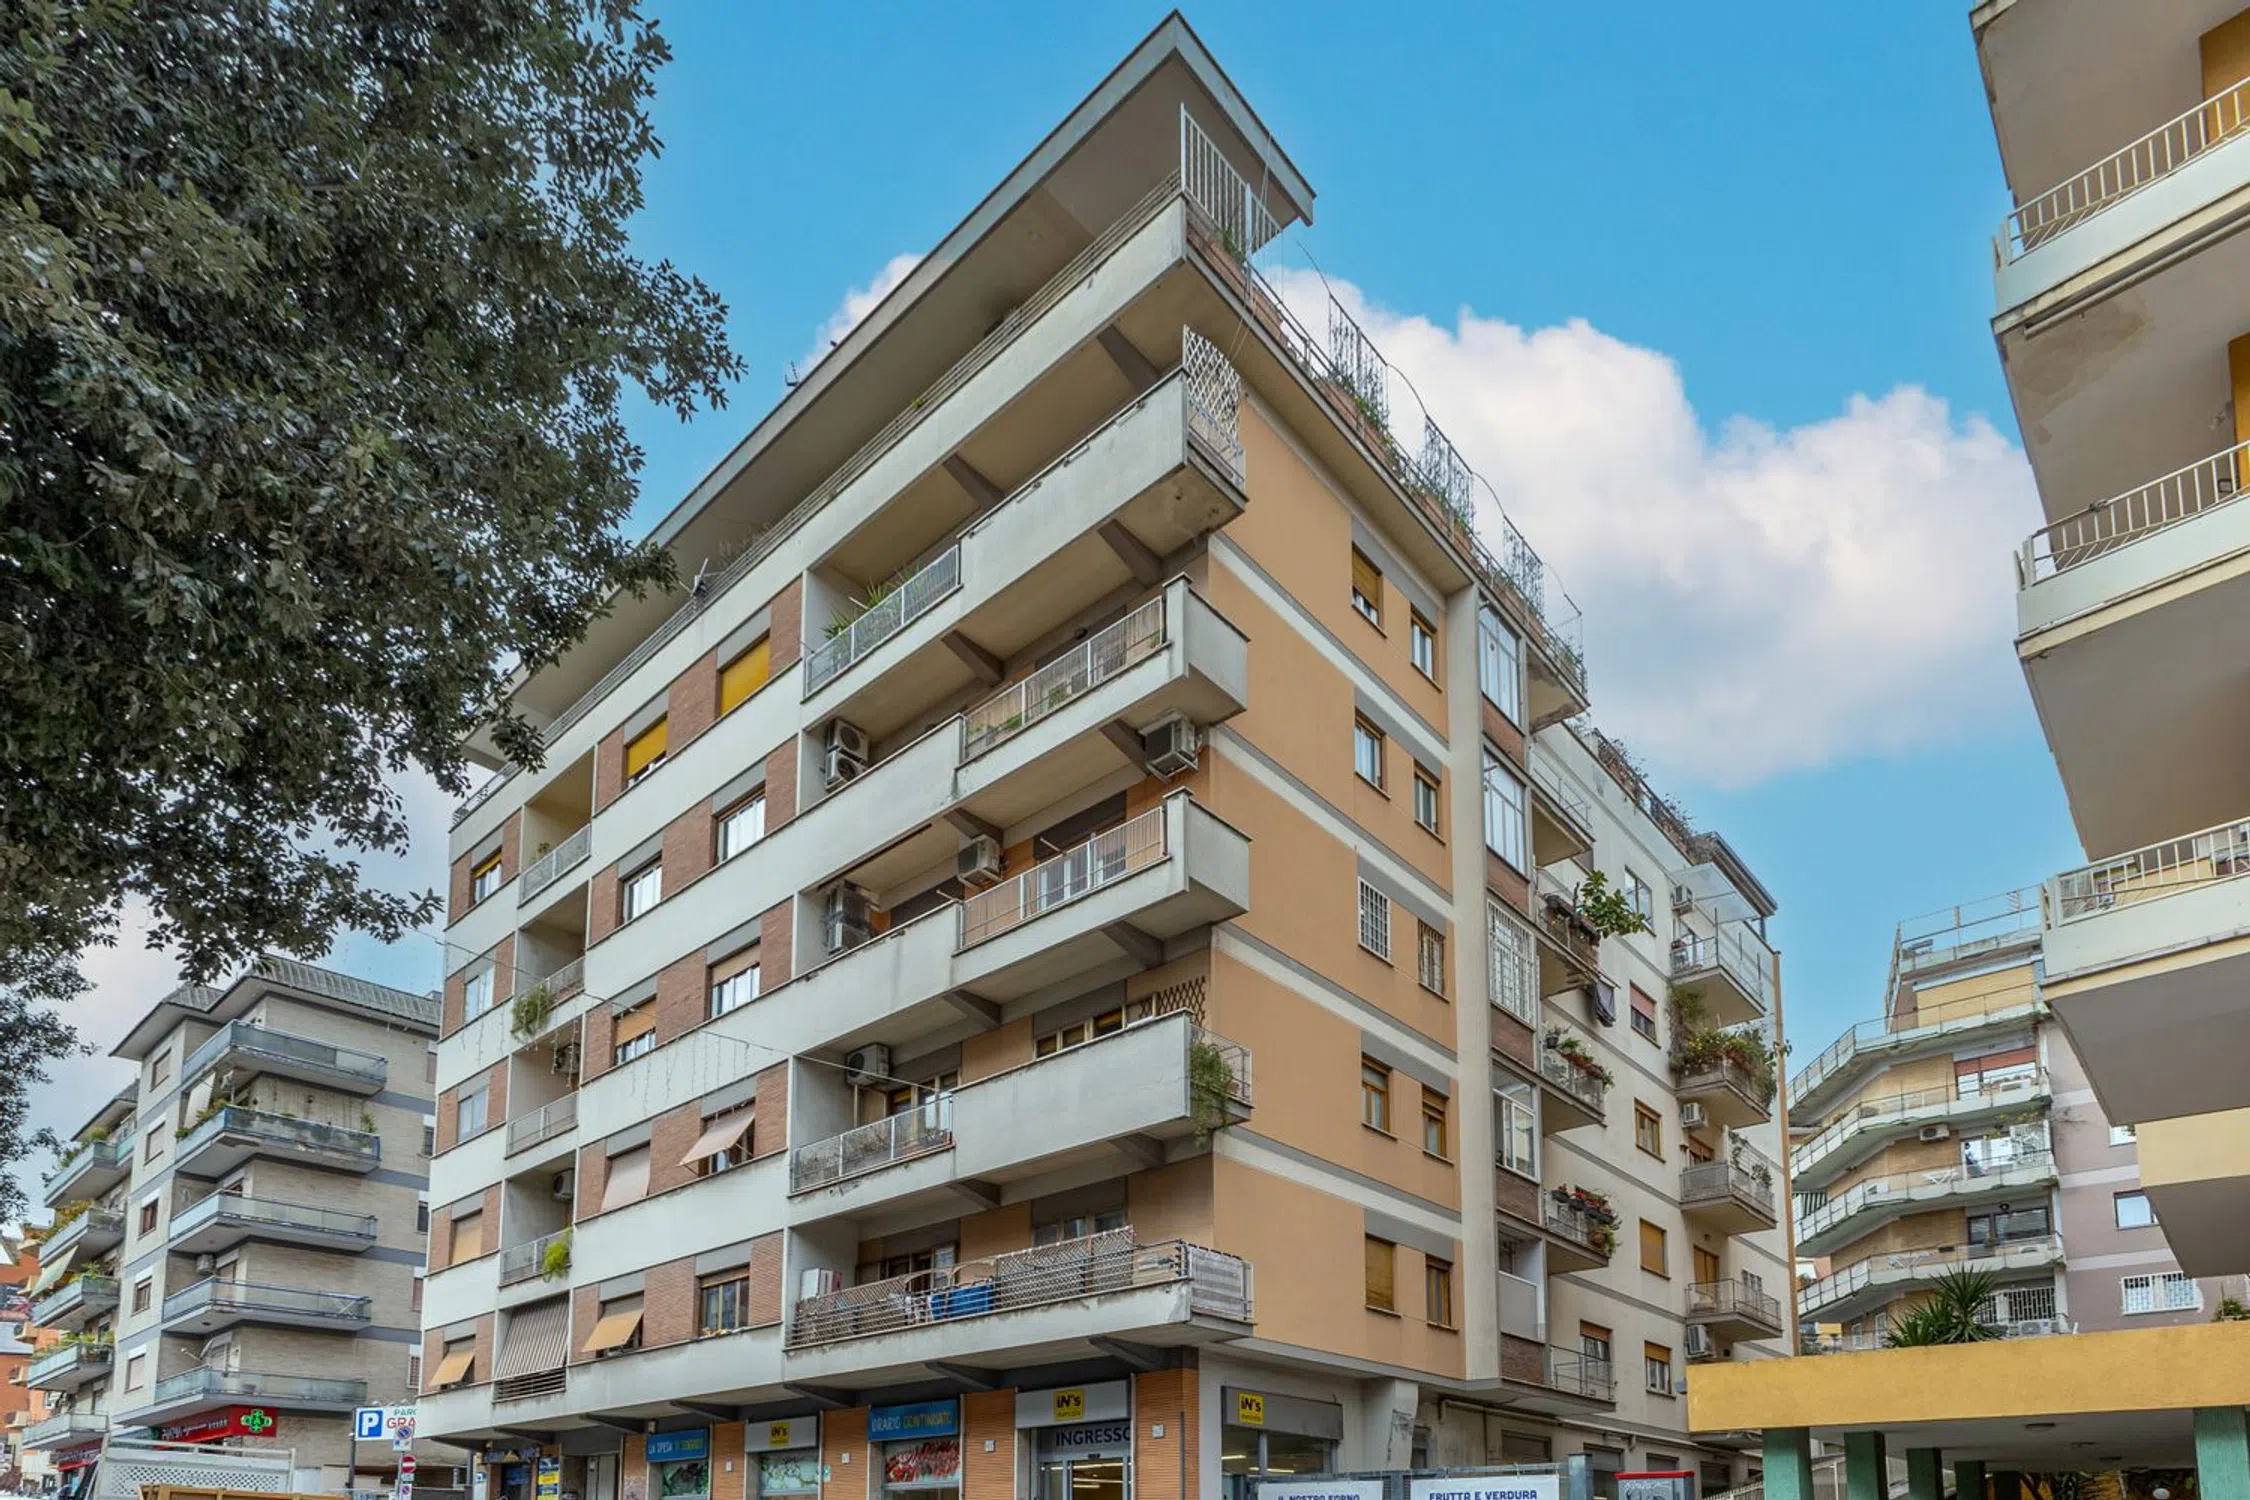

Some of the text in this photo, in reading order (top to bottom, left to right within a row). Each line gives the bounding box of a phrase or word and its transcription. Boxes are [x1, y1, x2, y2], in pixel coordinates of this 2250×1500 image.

[361, 1412, 380, 1436] P
[1429, 1489, 1538, 1500] FRUTTA E VERDURA
